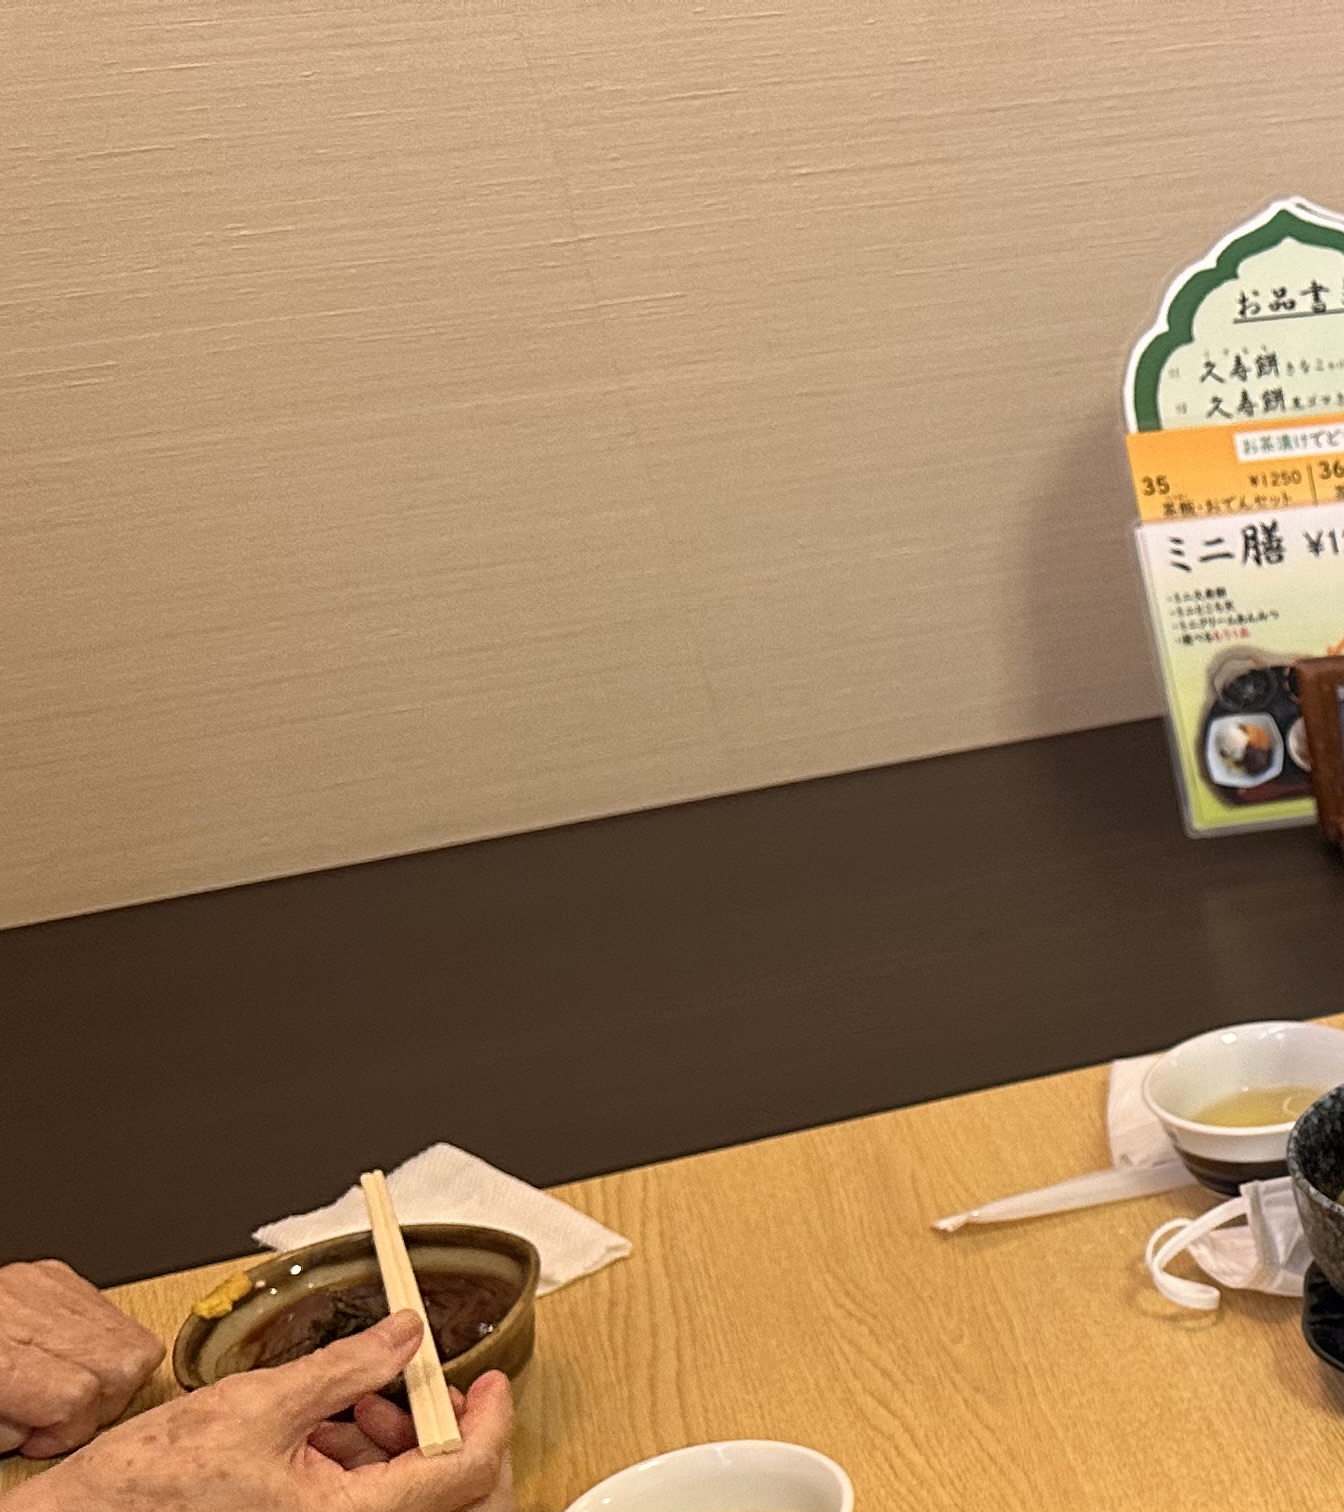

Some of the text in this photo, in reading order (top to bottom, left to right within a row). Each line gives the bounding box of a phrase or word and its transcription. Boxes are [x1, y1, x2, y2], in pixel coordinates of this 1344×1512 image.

[1140, 468, 1303, 496] 35 ¥1250
[1168, 517, 1285, 573] ミニ膳
